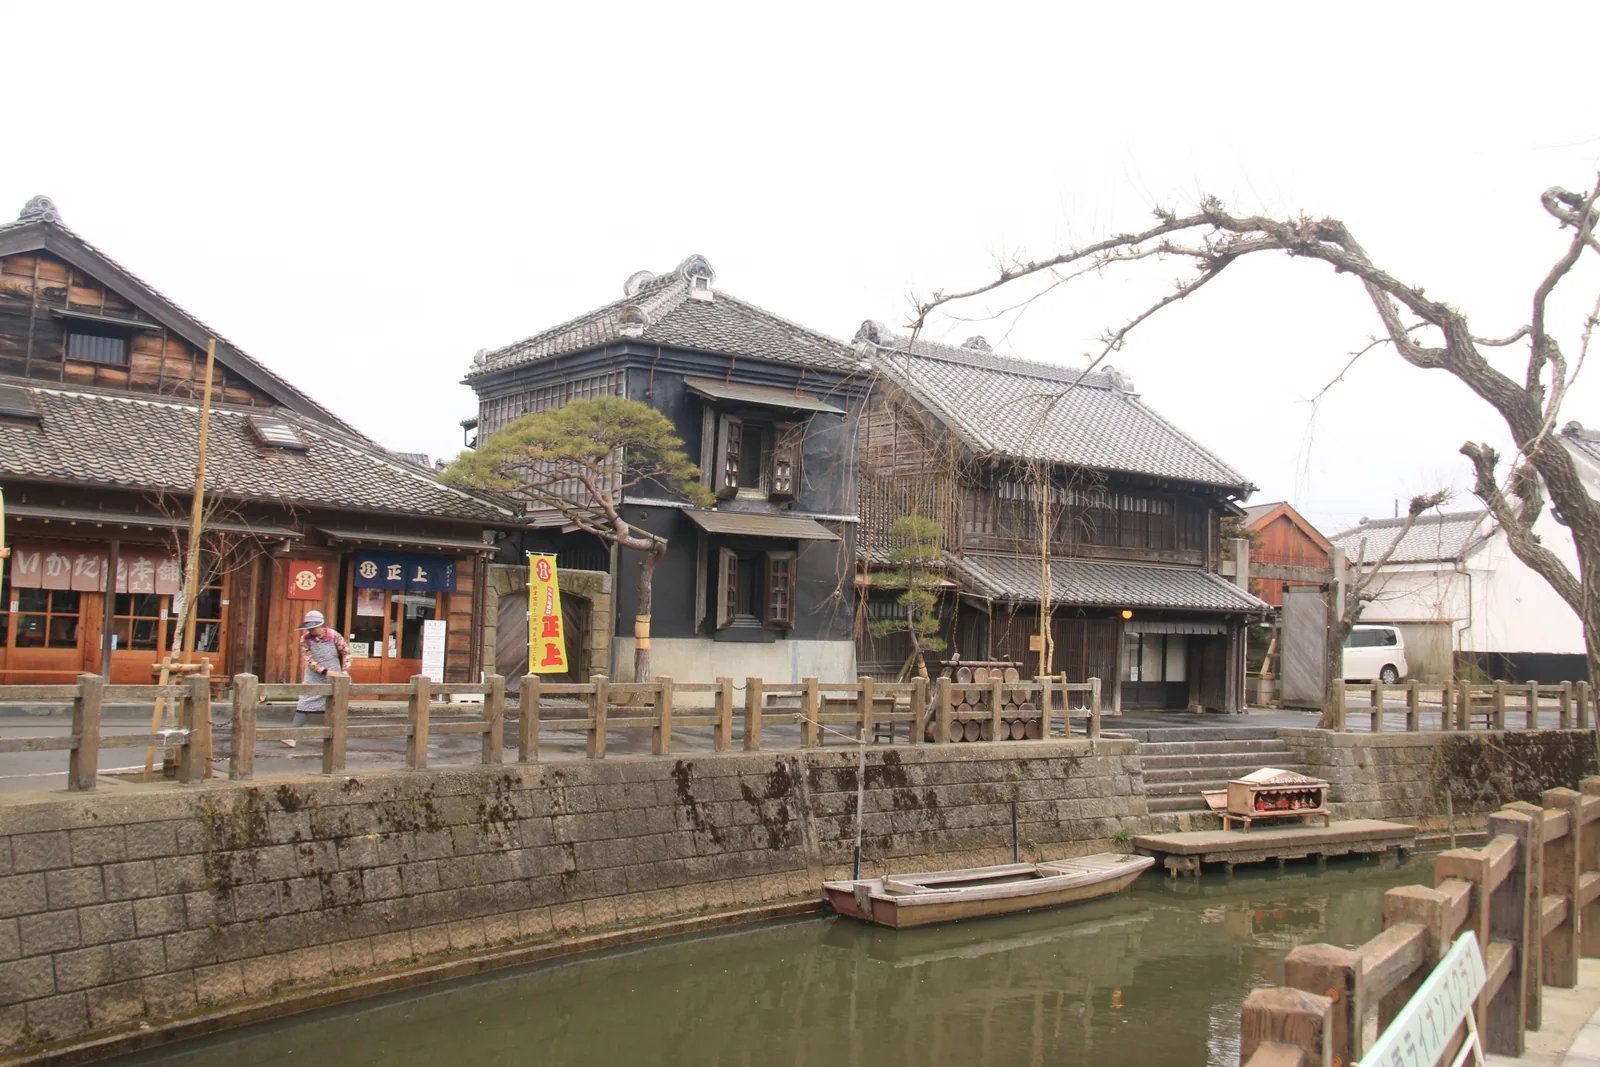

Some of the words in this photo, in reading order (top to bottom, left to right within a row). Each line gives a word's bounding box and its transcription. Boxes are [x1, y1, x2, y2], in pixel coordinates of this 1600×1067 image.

[387, 564, 428, 583] 正上
[541, 615, 563, 667] 正上
[1381, 944, 1477, 1067] ライオンズクラブ
